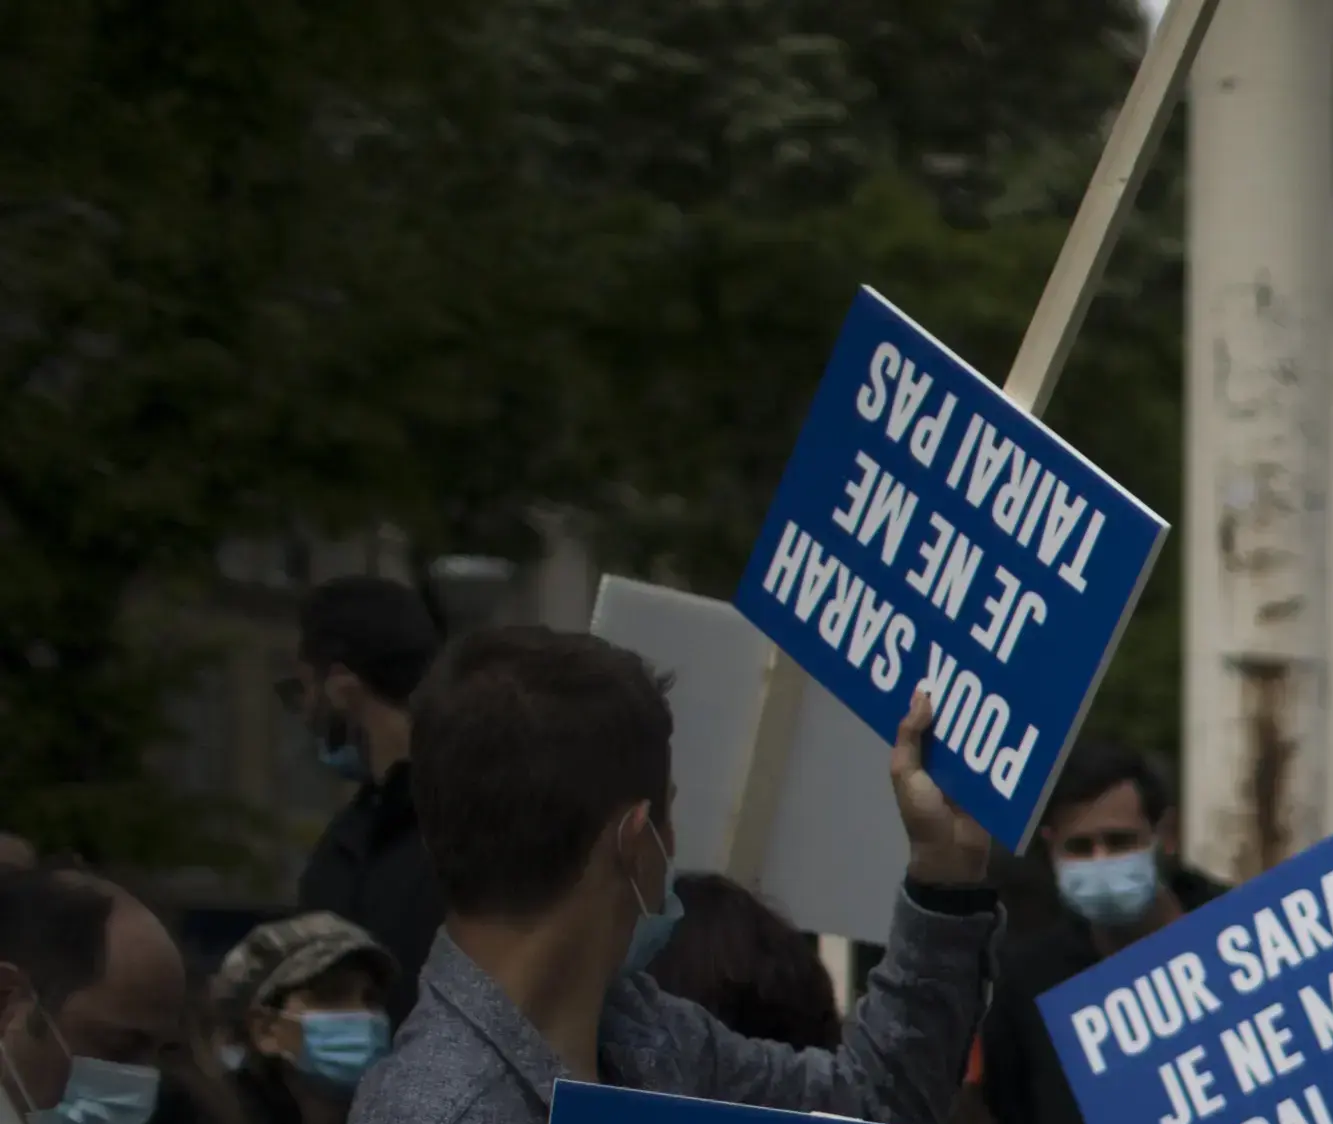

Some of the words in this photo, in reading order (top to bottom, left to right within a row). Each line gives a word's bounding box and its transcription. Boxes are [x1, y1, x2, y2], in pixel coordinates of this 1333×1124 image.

[855, 341, 958, 468] PAS
[832, 451, 920, 566] ME
[944, 413, 1107, 594] TAIRAI
[762, 520, 917, 694] SARAH
[904, 511, 984, 621] NE
[969, 565, 1048, 664] JE
[910, 640, 1040, 802] POUR
[1071, 951, 1221, 1074] POUR
[1219, 1004, 1305, 1094] NE
